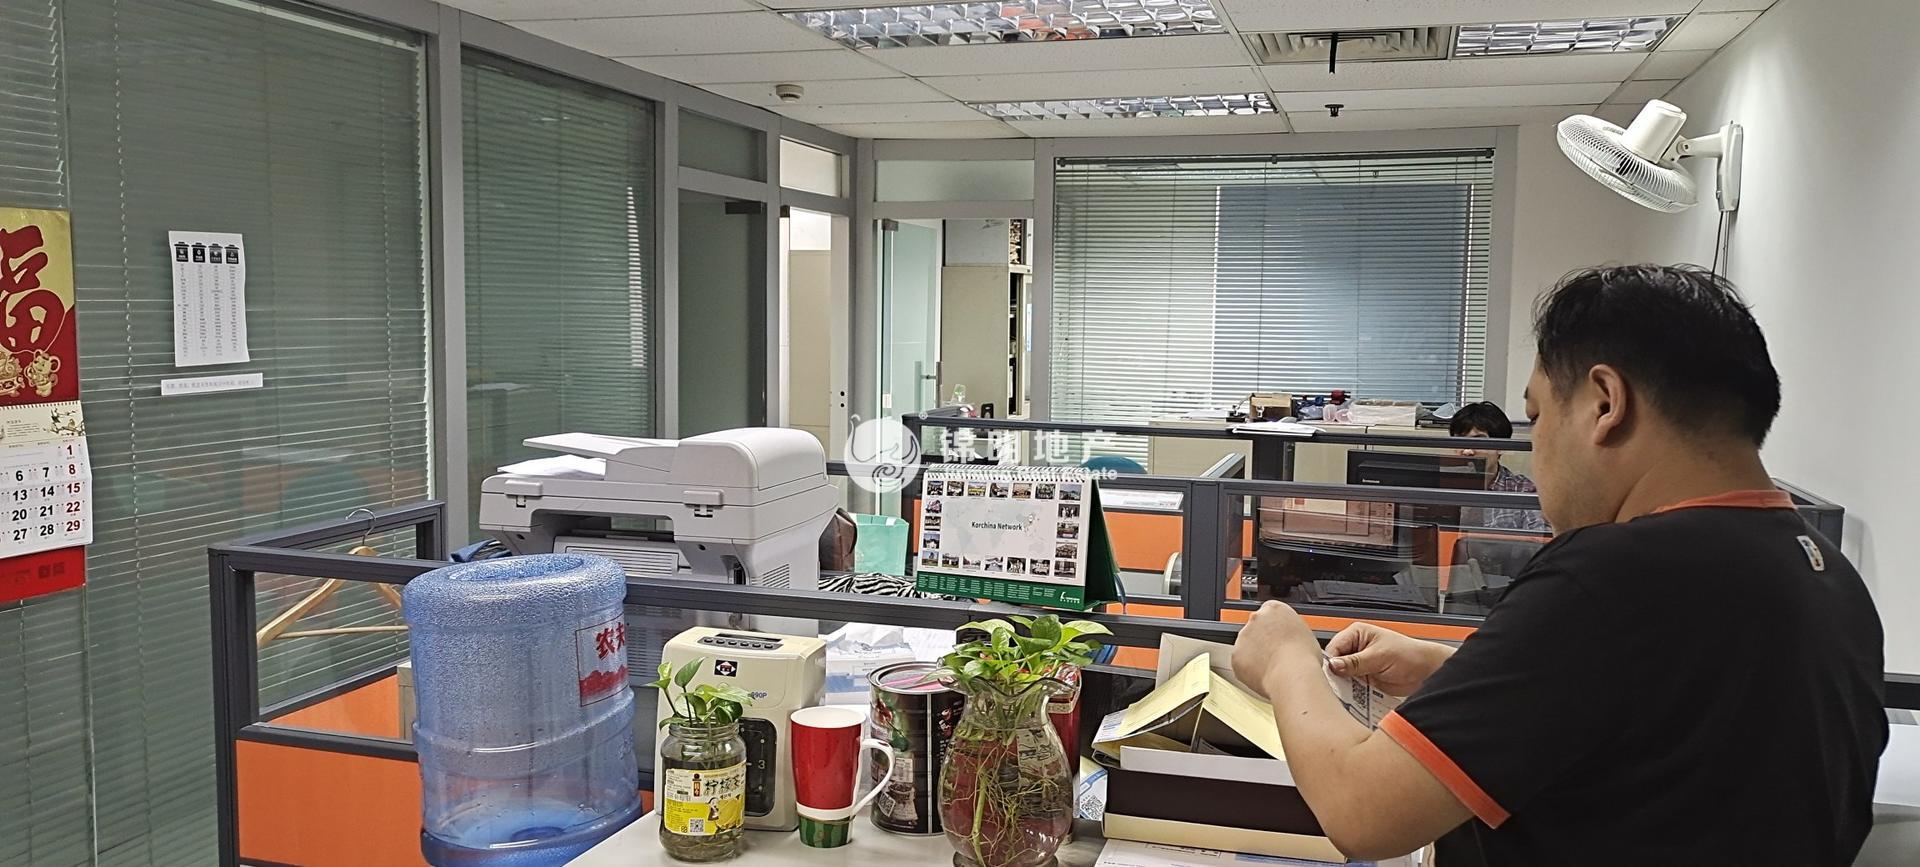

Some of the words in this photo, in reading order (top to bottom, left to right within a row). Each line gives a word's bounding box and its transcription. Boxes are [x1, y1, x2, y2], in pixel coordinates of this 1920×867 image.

[66, 445, 72, 455] 1
[15, 470, 24, 481] 6
[42, 467, 50, 478] 7
[68, 464, 76, 475] 8
[12, 489, 28, 501] 13
[40, 486, 55, 498] 14
[66, 482, 81, 494] 15
[12, 509, 28, 521] 20
[39, 505, 54, 517] 21
[66, 501, 81, 513] 22
[13, 528, 28, 541] 27
[39, 524, 54, 536] 28
[66, 520, 81, 532] 29
[971, 521, 997, 530] Korchina
[997, 523, 1023, 531] Network
[757, 760, 766, 770] 3
